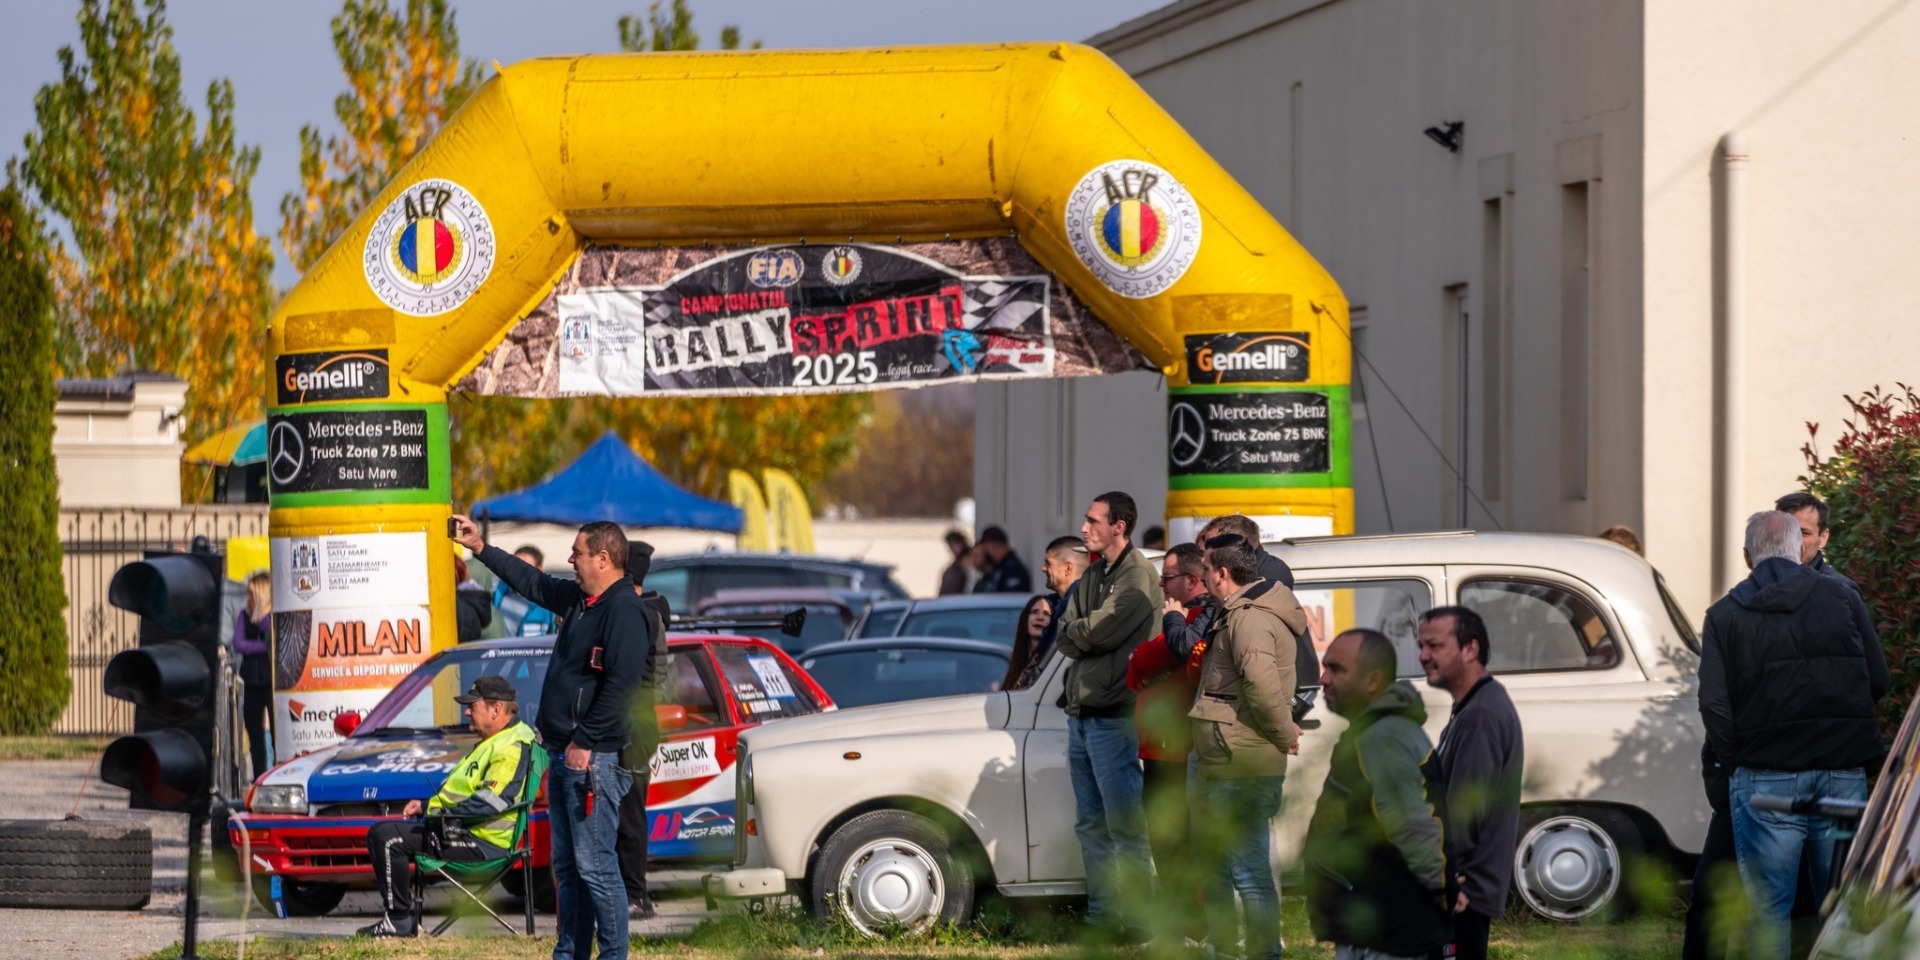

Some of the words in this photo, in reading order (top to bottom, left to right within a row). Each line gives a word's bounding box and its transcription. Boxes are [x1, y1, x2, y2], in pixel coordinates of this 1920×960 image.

[1102, 169, 1159, 205] ACR
[404, 187, 453, 225] ACR
[680, 289, 790, 315] CAMPIONATUL
[652, 314, 787, 367] RALLY
[794, 295, 961, 354] SPRINT
[791, 350, 878, 387] 2025
[1208, 403, 1326, 420] Mercedes-Benz
[308, 419, 424, 438] Mercedes-Benz
[1211, 429, 1246, 442] Truck
[1250, 429, 1281, 442] Zone
[1284, 428, 1300, 441] 75
[1302, 428, 1325, 440] BNK
[310, 445, 343, 460] Truck
[346, 445, 378, 458] Zone
[382, 444, 397, 458] 75
[400, 444, 422, 458] BNK
[1240, 451, 1268, 464] Satu
[1271, 451, 1300, 463] Mare
[338, 466, 364, 480] Satu
[368, 466, 397, 479] Mare
[318, 618, 421, 658] MILAN
[311, 666, 344, 679] SERVICE
[353, 663, 388, 676] DEPOZIT
[291, 729, 312, 741] Satu
[314, 729, 341, 739] Mar
[659, 746, 690, 767] Super
[691, 741, 708, 760] OK
[677, 827, 708, 840] MOTOR
